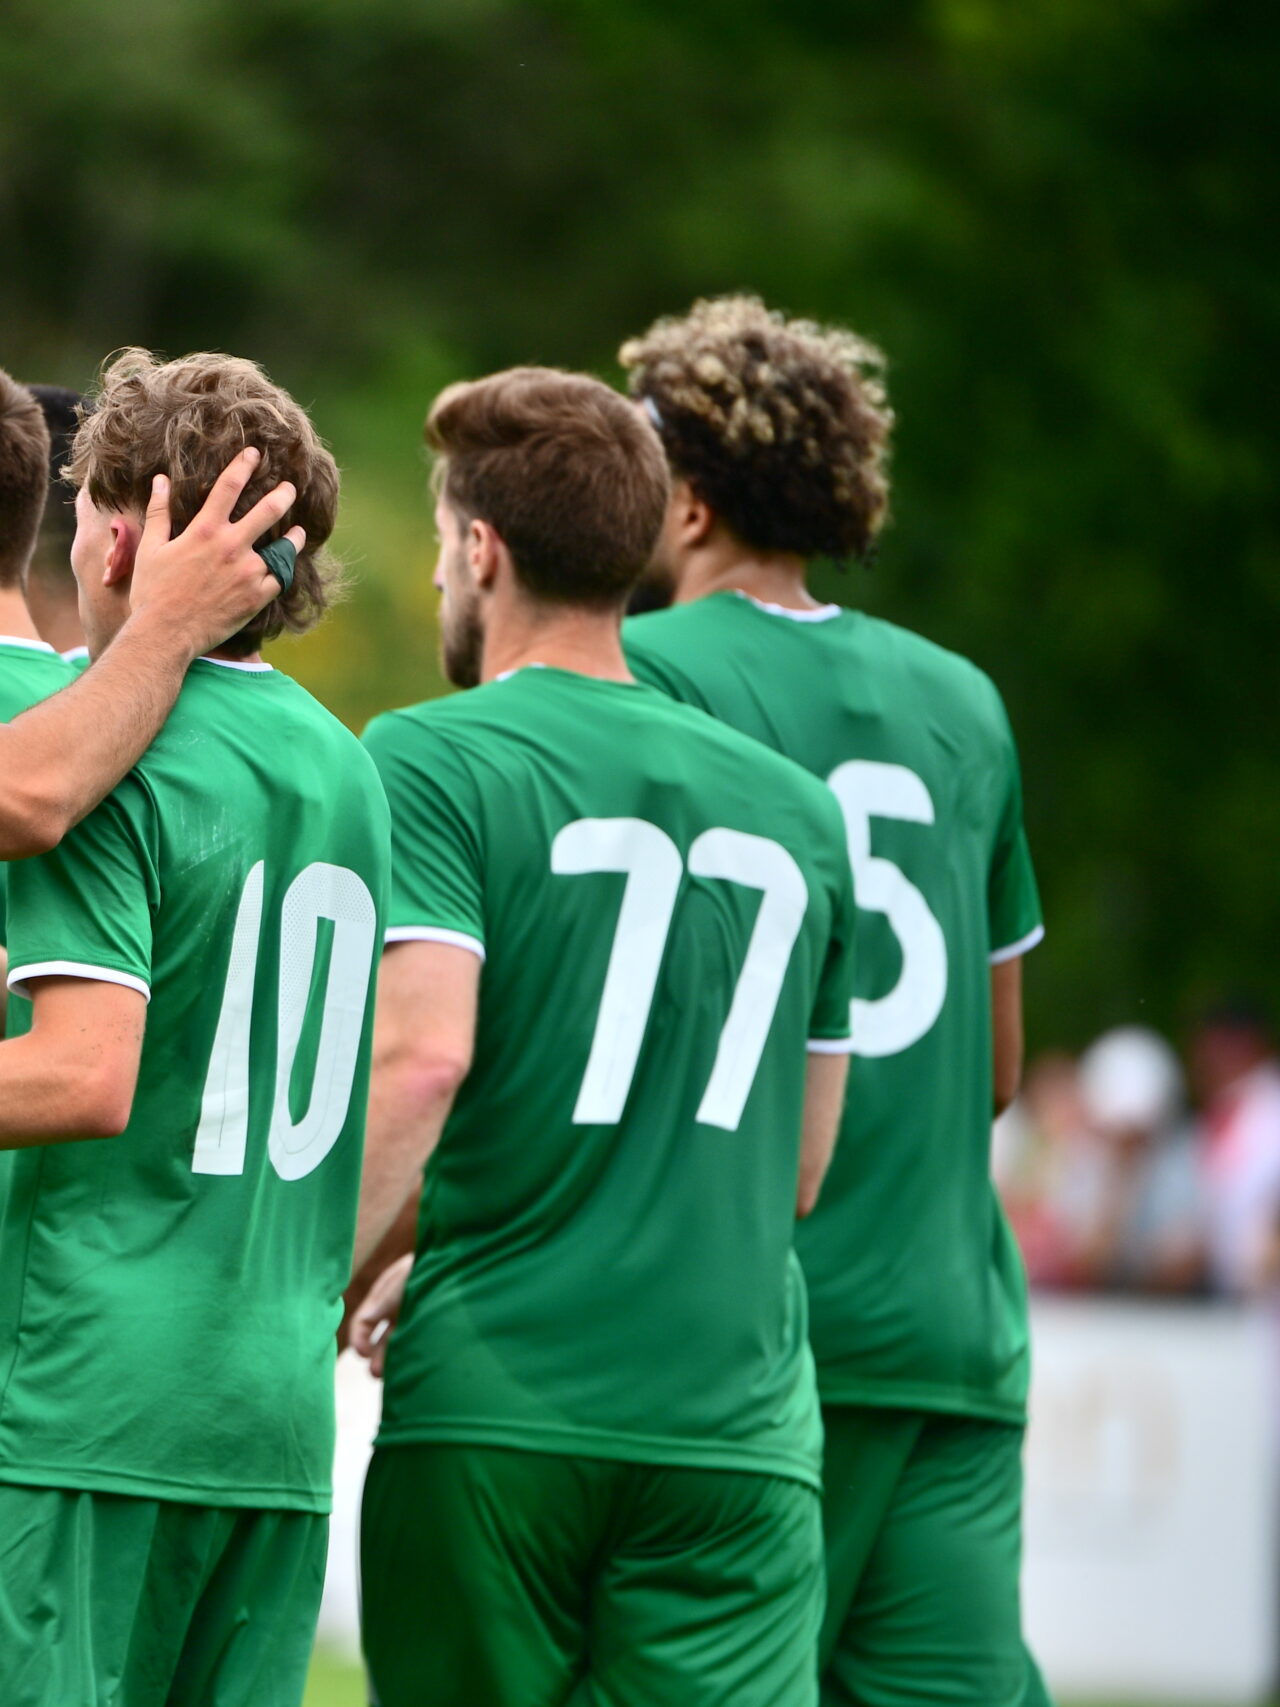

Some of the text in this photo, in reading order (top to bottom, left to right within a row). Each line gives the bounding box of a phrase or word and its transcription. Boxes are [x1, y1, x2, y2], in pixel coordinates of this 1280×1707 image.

[191, 859, 377, 1181] 10
[551, 817, 808, 1131] 77
[827, 760, 948, 1057] 5
